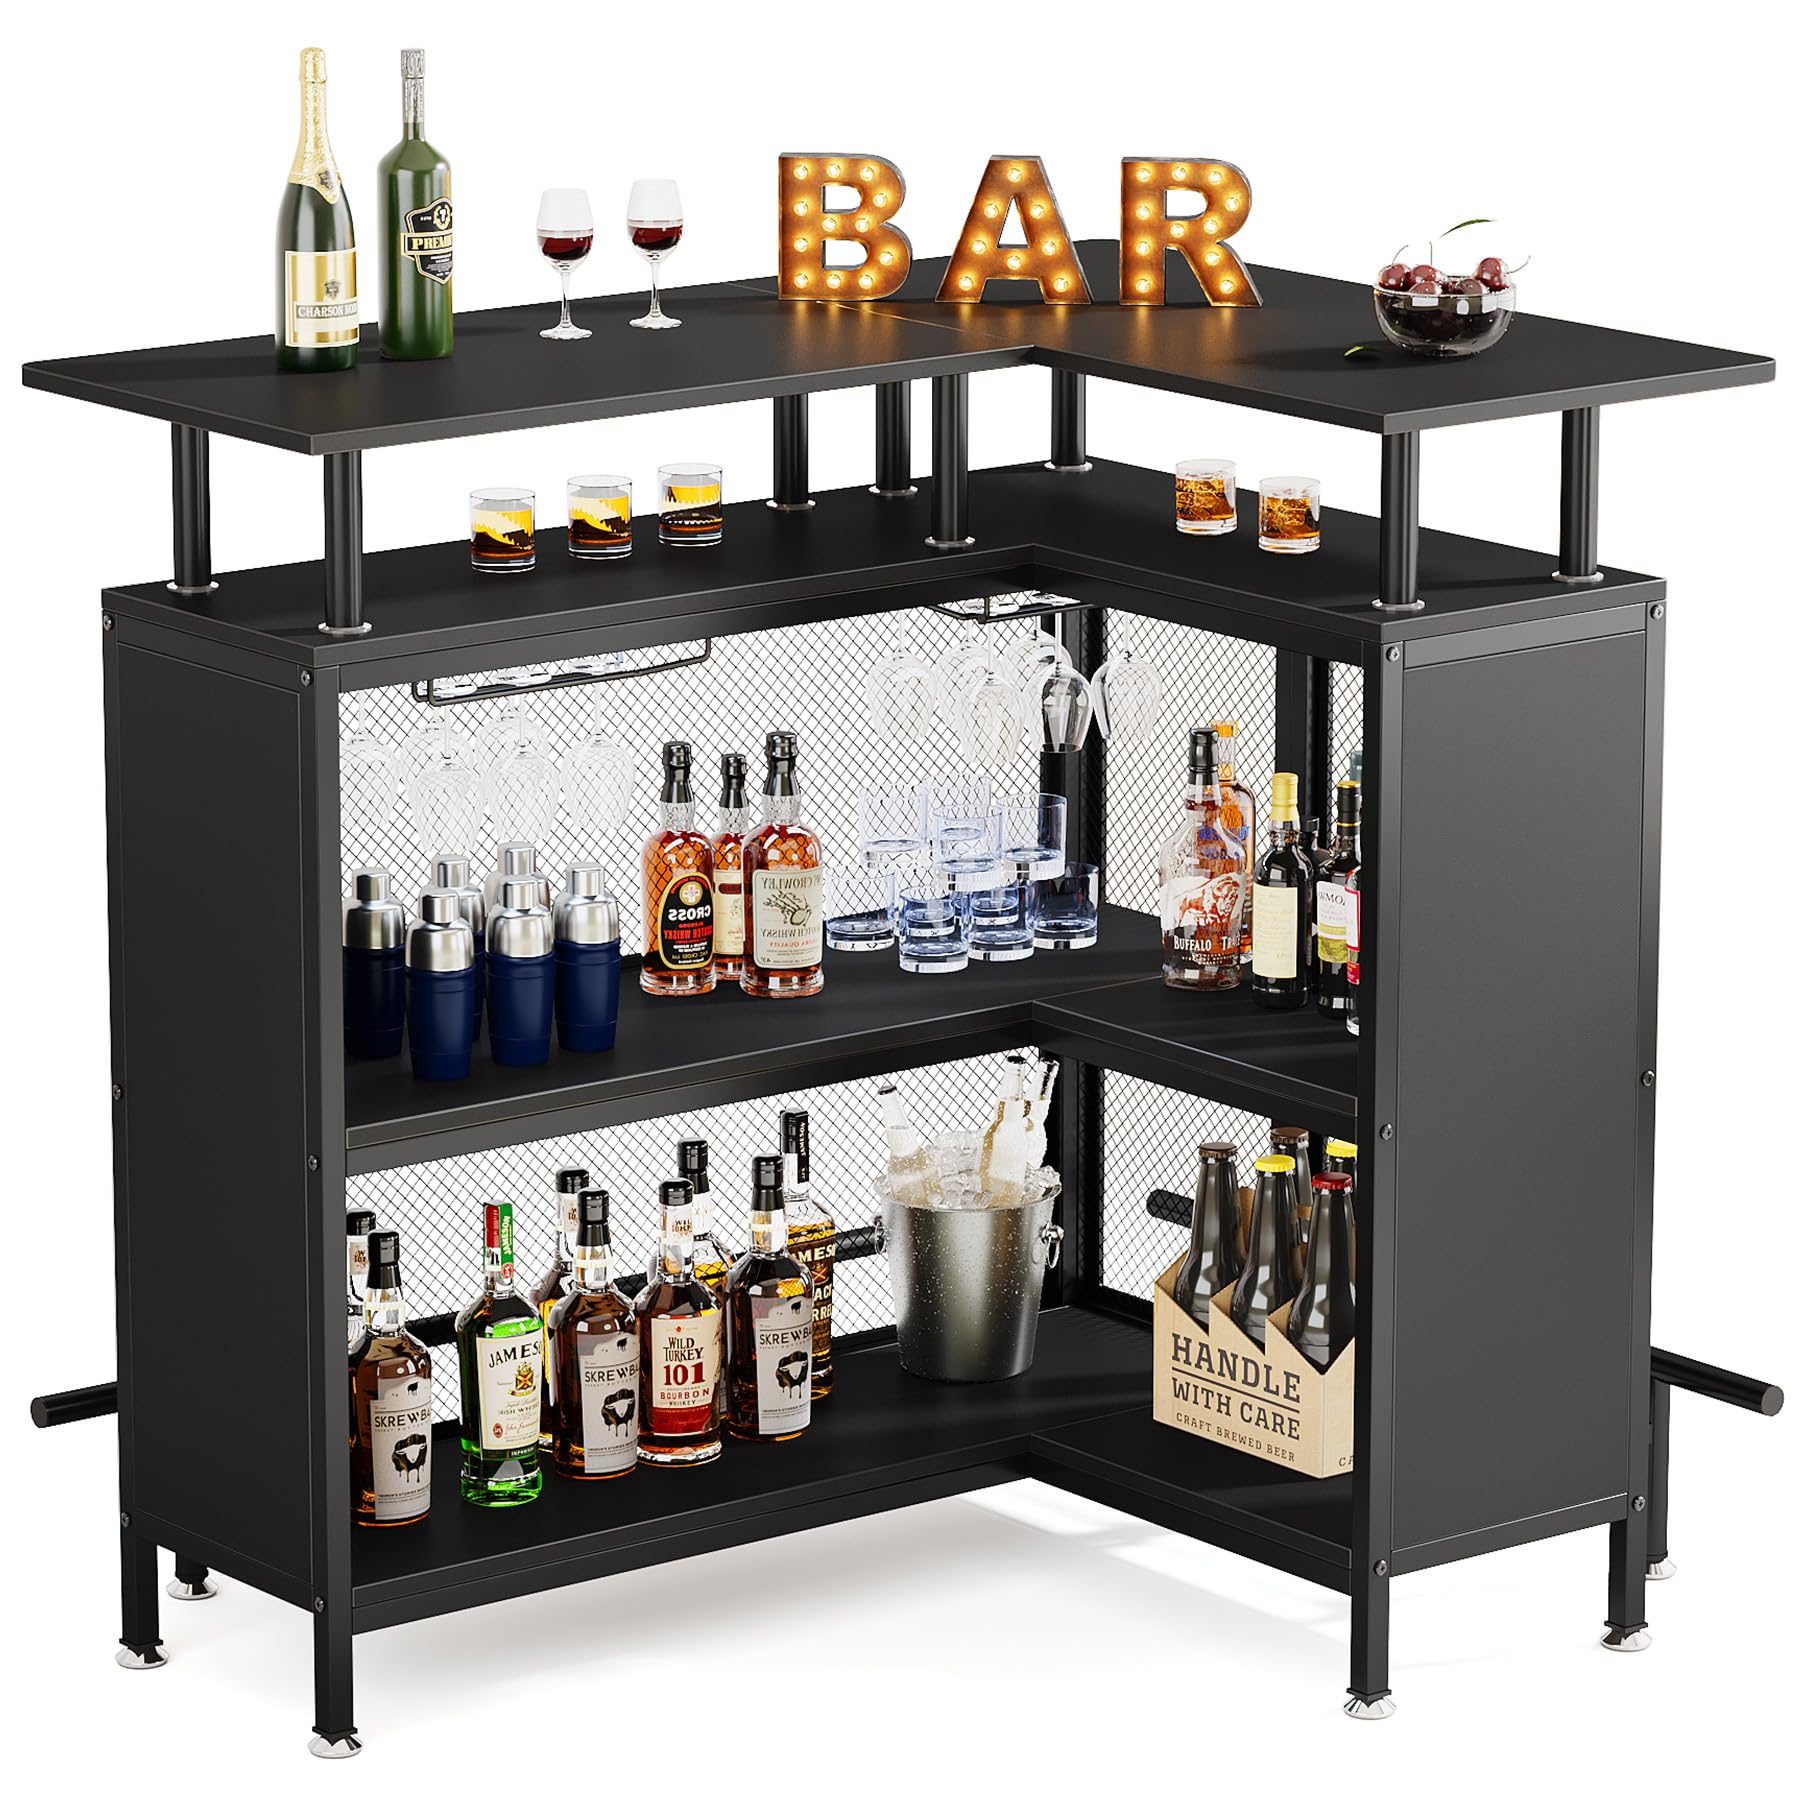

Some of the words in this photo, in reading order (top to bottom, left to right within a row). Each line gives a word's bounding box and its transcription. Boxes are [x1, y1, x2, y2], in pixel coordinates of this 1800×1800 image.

[778, 152, 1263, 308] BAR
[297, 305, 344, 318] CHARSON
[1174, 935, 1212, 951] BUFFALO
[502, 1216, 512, 1256] JAMESON
[663, 1347, 704, 1362] TURKEY
[668, 1337, 695, 1349] WILD
[663, 1362, 705, 1386] 101
[1172, 1332, 1300, 1403] HANDLE
[660, 1388, 710, 1400] BOURBON
[1172, 1377, 1231, 1416] WITH
[1240, 1401, 1300, 1440] CARE
[1176, 1412, 1212, 1433] CRAFT
[1216, 1426, 1262, 1450] BREWED
[1267, 1444, 1295, 1462] BEER
